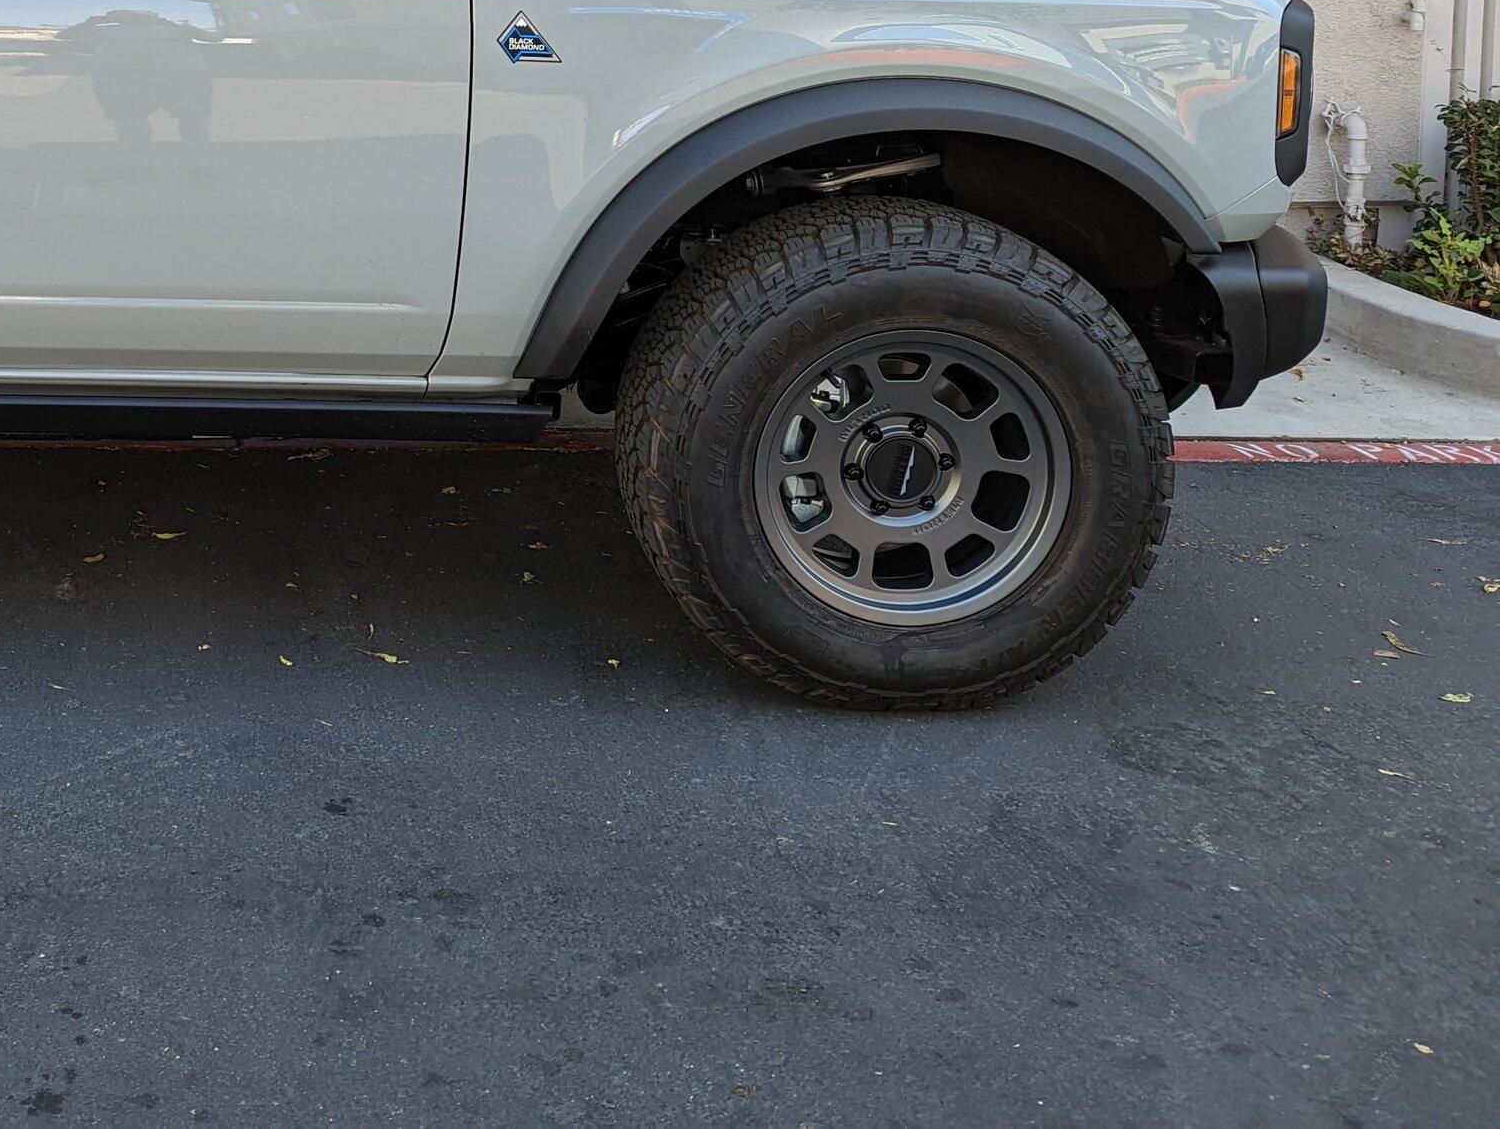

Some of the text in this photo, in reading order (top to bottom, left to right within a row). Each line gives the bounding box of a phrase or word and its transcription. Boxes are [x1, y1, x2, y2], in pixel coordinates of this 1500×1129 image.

[508, 43, 545, 51] DIAMOND
[705, 305, 843, 489] GENERAL
[1226, 443, 1319, 459] NO
